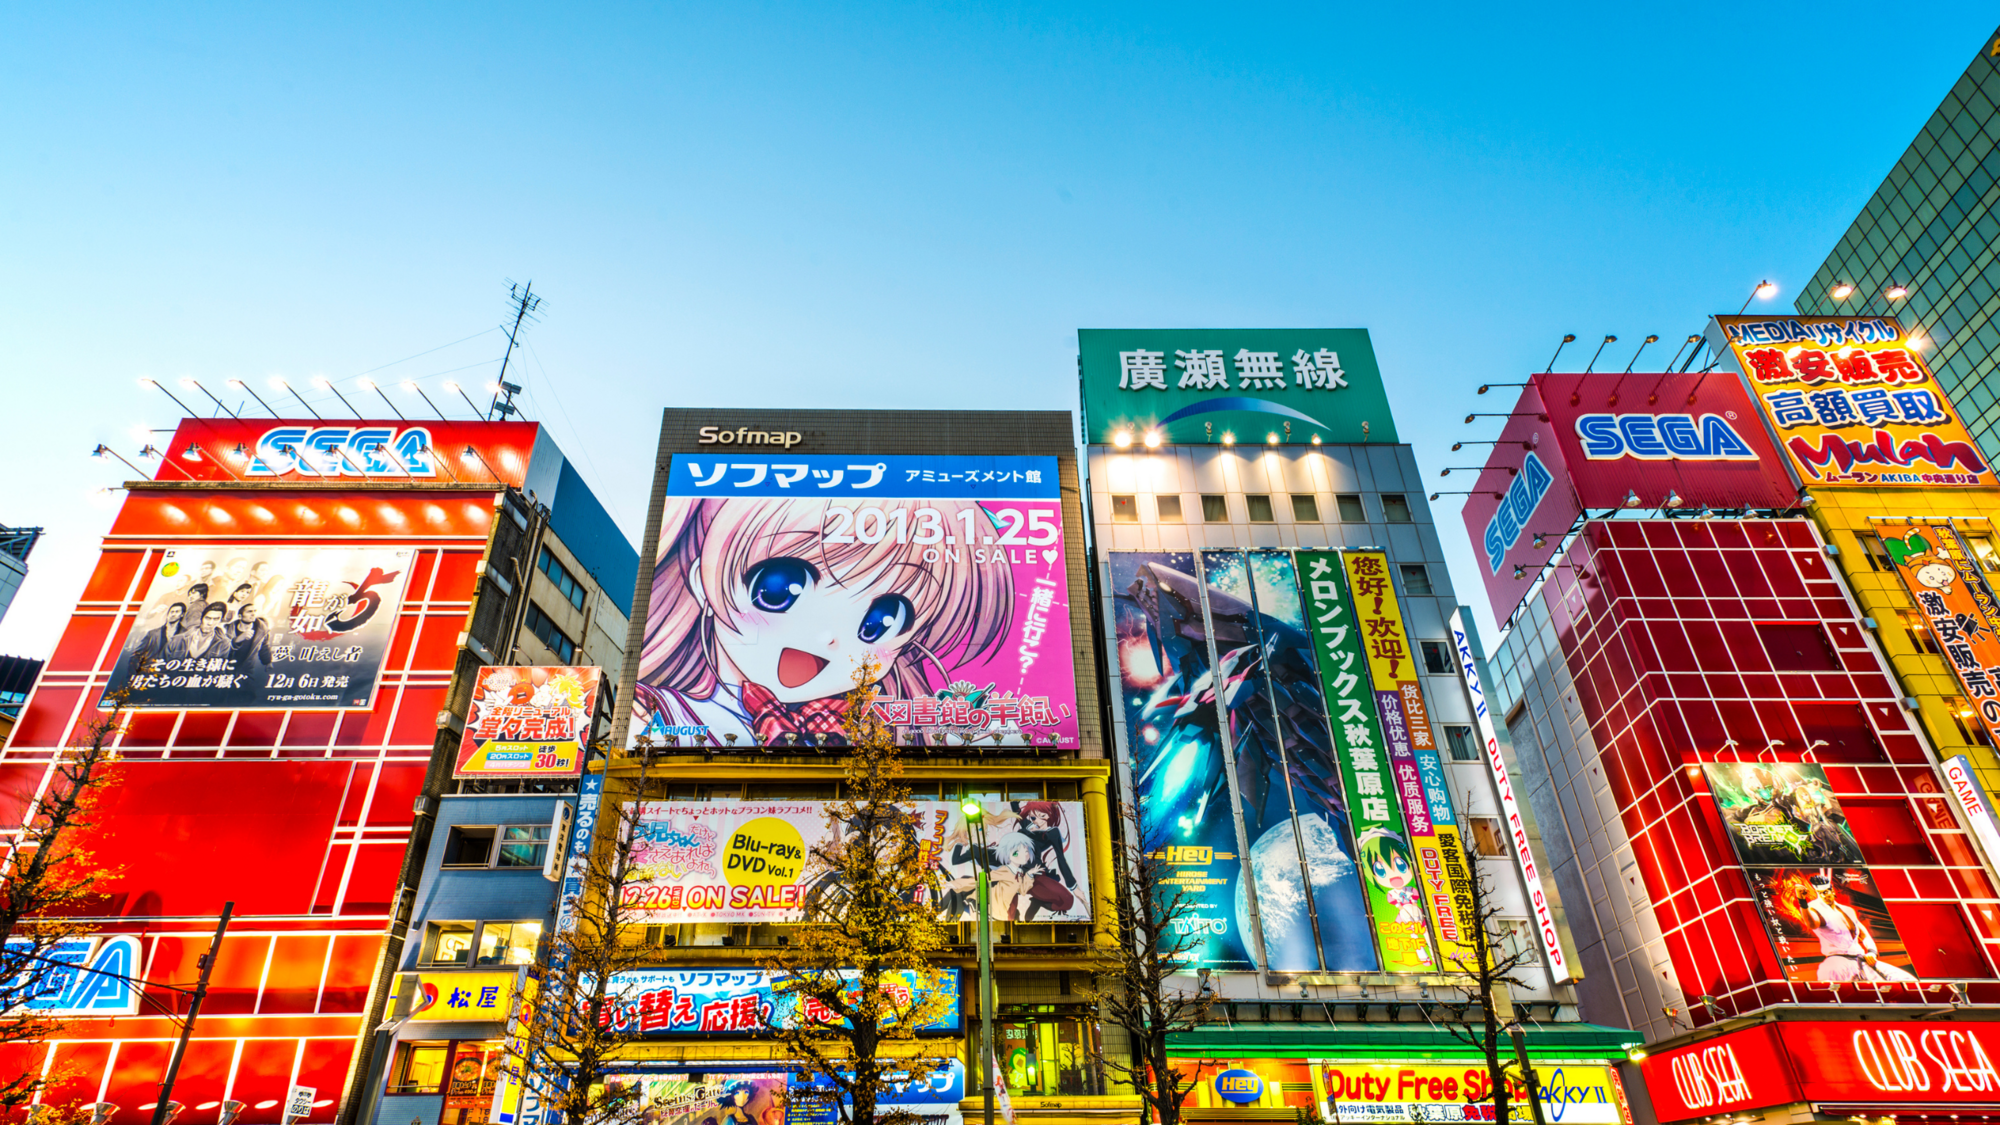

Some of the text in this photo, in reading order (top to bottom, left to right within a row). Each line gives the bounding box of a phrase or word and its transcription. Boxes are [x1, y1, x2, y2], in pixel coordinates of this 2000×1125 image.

[1728, 320, 1898, 346] MEDIAリサイクル
[1118, 348, 1349, 390] 廣瀬無線
[1745, 348, 1922, 384] 激安販売
[1764, 389, 1946, 427] 高額買取
[699, 427, 801, 448] Sofmap
[1575, 414, 1759, 460] SEGA
[246, 427, 436, 477] SEGA
[688, 462, 1042, 488] ソフマップ アミューズメント館
[1826, 472, 1878, 483] ムーラン
[1881, 474, 1921, 483] AKIBA
[821, 508, 1058, 546] 2013.1.25
[1484, 450, 1555, 576] SEGA
[923, 549, 1037, 564] ON SALE
[1351, 556, 1406, 679] 您好!欢迎!
[151, 658, 237, 672] その生き様に
[272, 646, 363, 662] 夢、叶えし者
[1454, 630, 1482, 696] AKKY
[1917, 591, 2000, 740] 激安販売の
[130, 674, 248, 688] 男たちの血が騒ぐ
[265, 674, 349, 688] 12月 6日 発売
[1309, 557, 1390, 821] メロンブックス秋葉原店
[267, 693, 338, 701] ryu-ga-gotoku.com
[473, 717, 575, 740] 堂々完成!
[1381, 694, 1411, 758] 价格优惠
[1401, 684, 1432, 747] 货比三家
[664, 726, 709, 736] AUGUST
[1398, 764, 1429, 833] 优质服务
[1419, 754, 1451, 822] 安心购物
[1949, 766, 1983, 817] GAME
[574, 793, 598, 854] 売るのも
[727, 854, 794, 878] DVD Vol.1
[1166, 846, 1213, 865] Hey
[1487, 737, 1562, 967] DUTY FREE SHOP
[618, 885, 672, 910] 12.26
[686, 884, 726, 909] ON
[729, 884, 807, 910] SALE!
[1420, 848, 1459, 942] DUTY FREE
[1170, 912, 1227, 934] TAITO
[1379, 921, 1426, 936] このビル
[1386, 937, 1426, 951] 地下1F
[680, 973, 762, 986] ソフマップ
[447, 986, 499, 1008] 松屋
[1853, 1029, 2000, 1093] CLUB SEGA
[1221, 1077, 1258, 1094] Hey
[1330, 1069, 1391, 1102] Duty
[1398, 1070, 1459, 1100] Free
[1671, 1056, 1712, 1110] CLUB
[1702, 1043, 1753, 1106] SEGA
[1336, 1104, 1534, 1121] 外向け電気製品 秋葉原免税場
